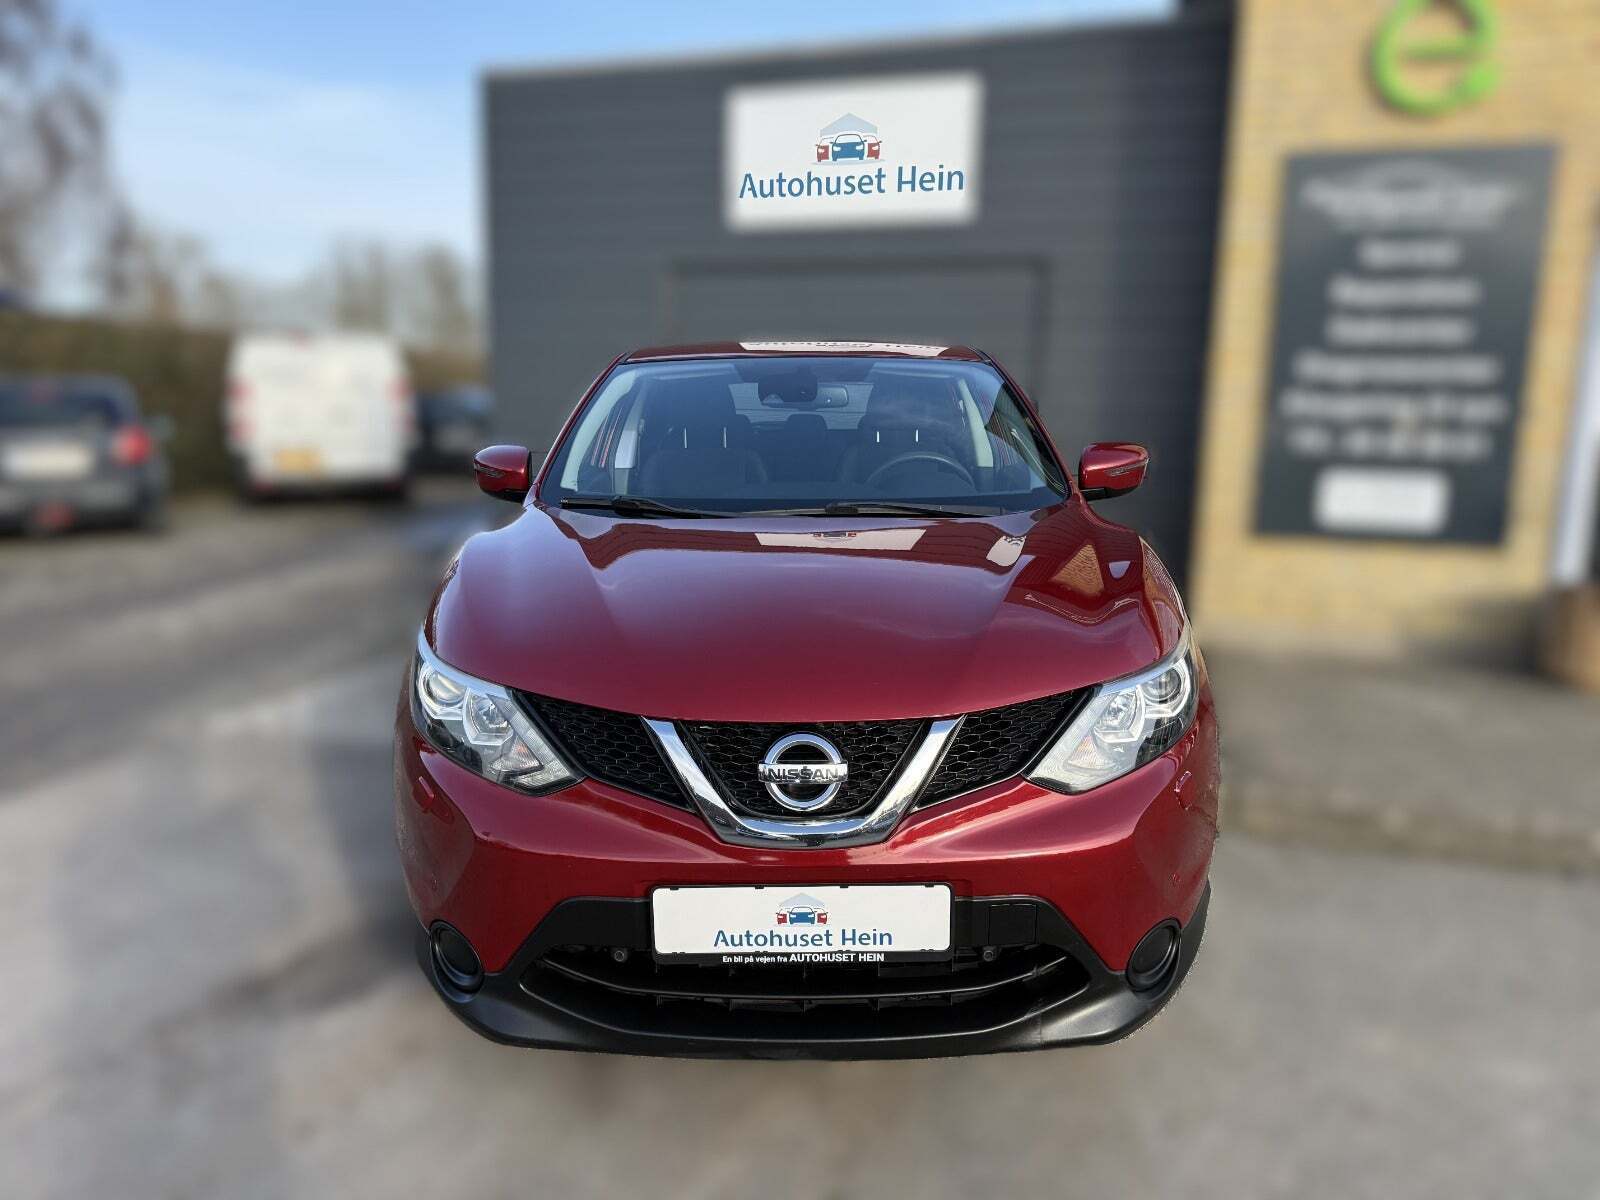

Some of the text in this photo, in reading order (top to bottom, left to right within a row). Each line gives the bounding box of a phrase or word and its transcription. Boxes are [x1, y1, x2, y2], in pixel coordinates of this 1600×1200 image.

[739, 164, 964, 199] Autohuset Hein
[767, 767, 839, 780] NISSAN
[714, 928, 892, 948] Autohuset Hein
[744, 955, 754, 964] på
[755, 956, 775, 964] vejen
[777, 955, 788, 963] fra
[789, 953, 856, 962] AUTOHUSET
[858, 953, 885, 962] HEIN
